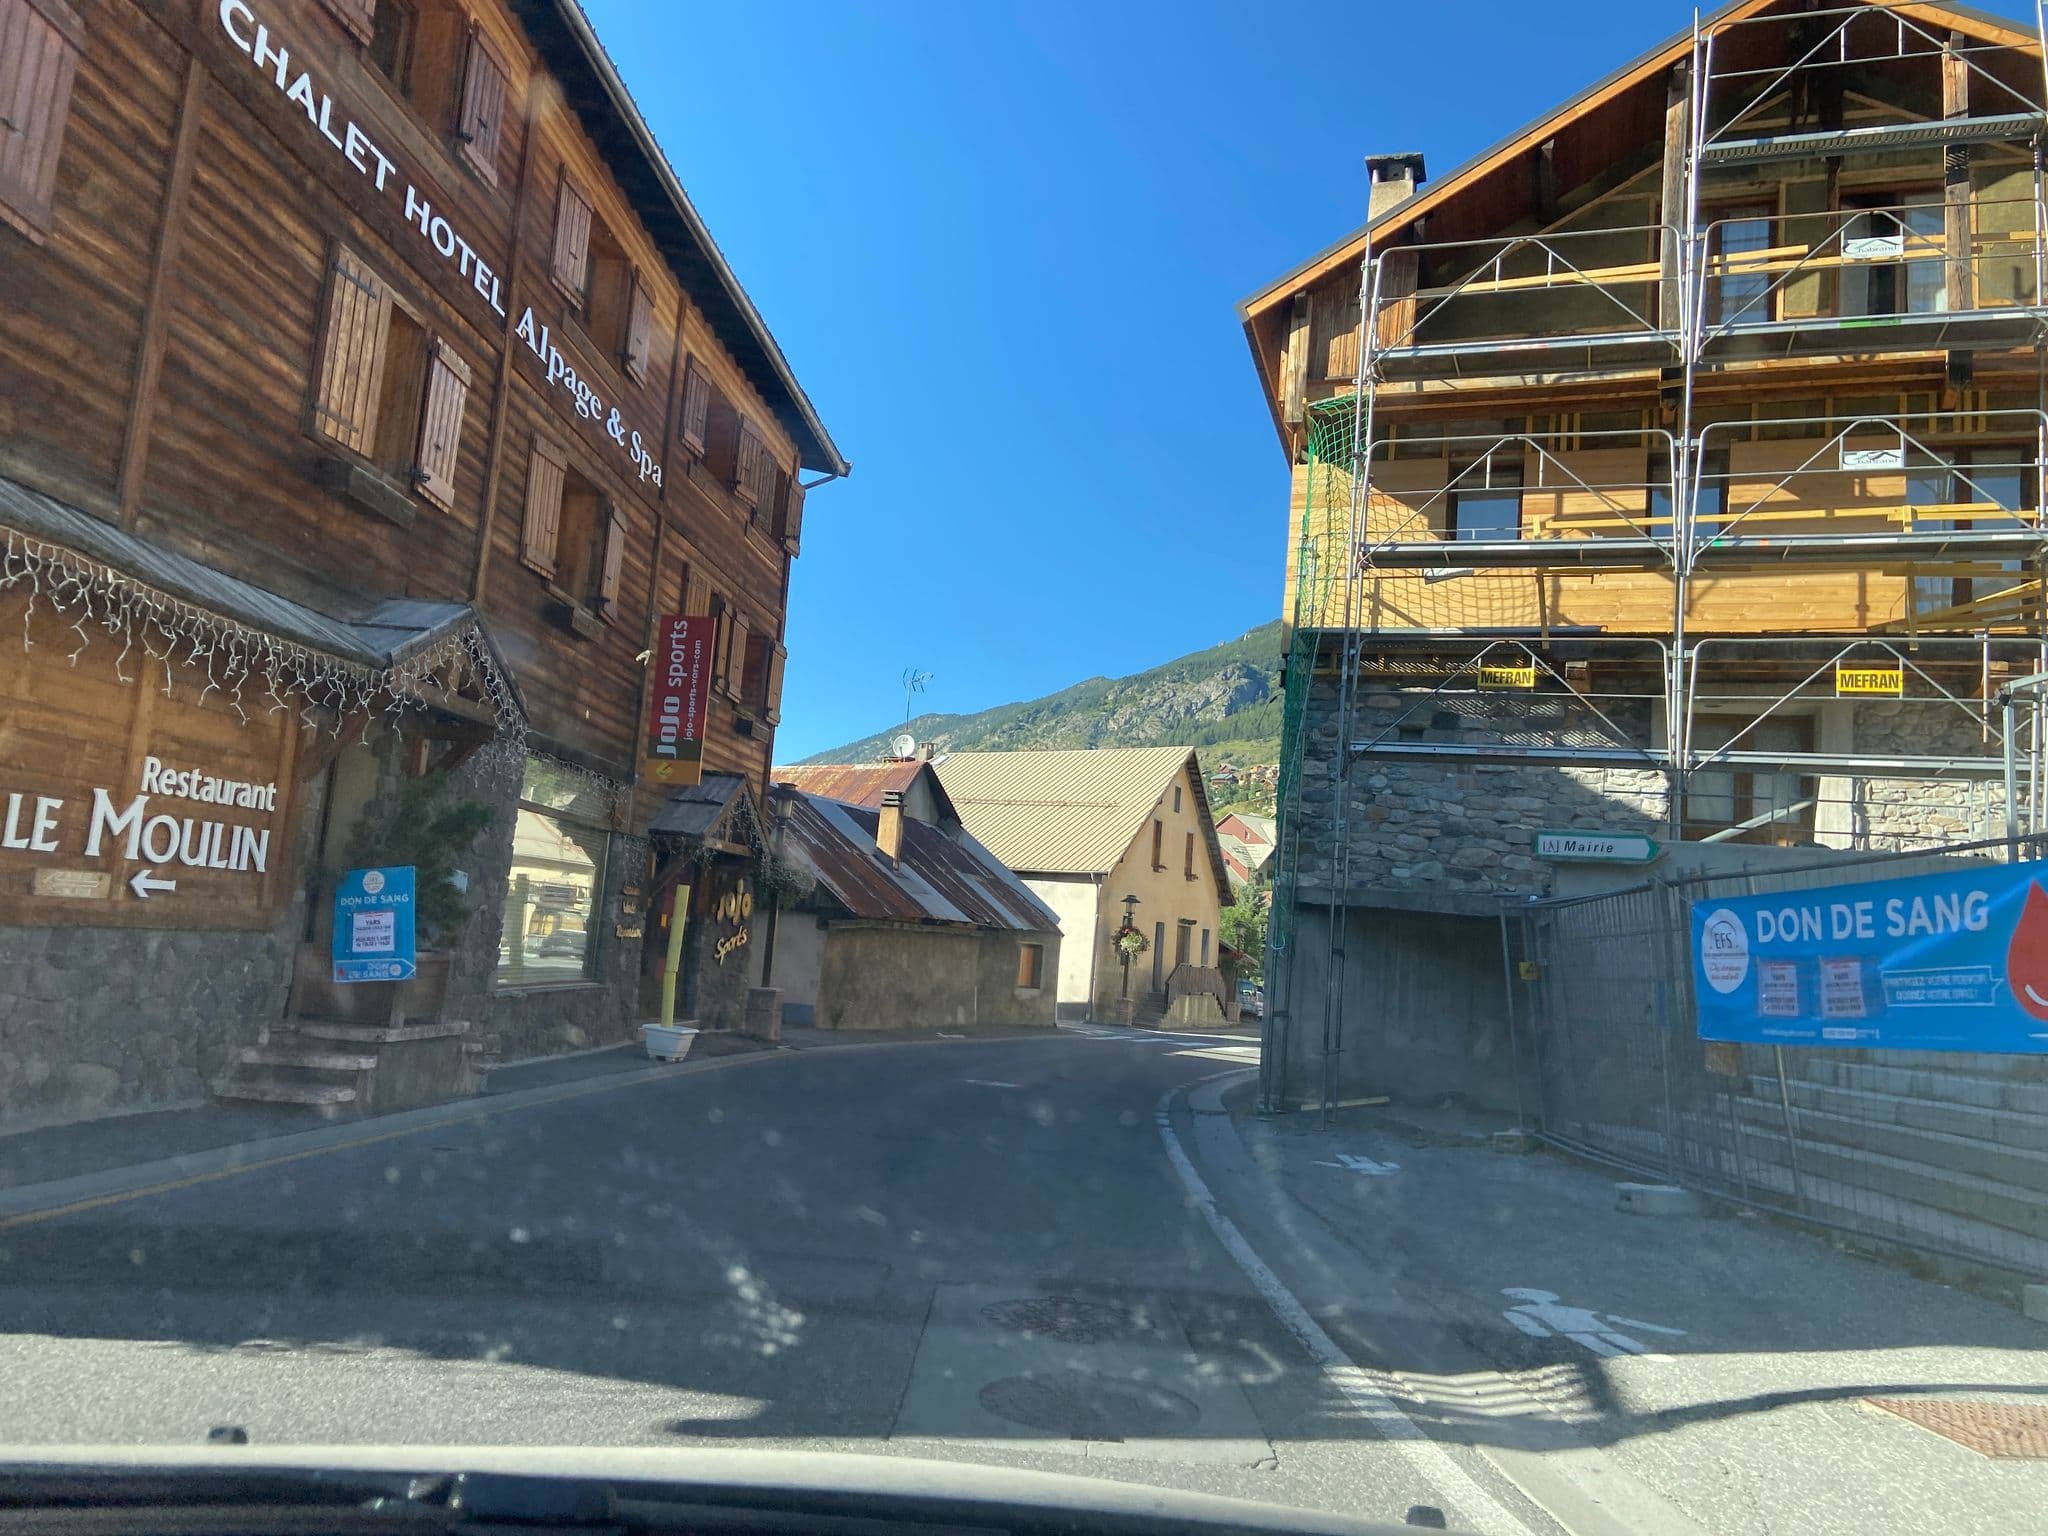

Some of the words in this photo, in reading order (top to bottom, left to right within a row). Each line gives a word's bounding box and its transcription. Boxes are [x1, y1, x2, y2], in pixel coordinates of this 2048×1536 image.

[219, 0, 396, 192] CHALET
[403, 184, 507, 318] HOTEL
[515, 306, 603, 421] Alpage
[606, 407, 627, 446] &
[629, 429, 663, 489] Spa
[668, 619, 688, 688] sports
[1480, 671, 1531, 684] MEFRAN
[1840, 673, 1899, 689] MEFRAN
[141, 756, 277, 812] Restaurant
[1, 793, 64, 852] LE
[84, 788, 271, 873] MOULIN
[1563, 840, 1615, 853] Mairie
[340, 896, 362, 906] DON
[364, 895, 378, 904] DE
[381, 893, 410, 904] SANG
[1756, 905, 1823, 944] DON
[1831, 901, 1876, 940] DE
[1886, 890, 1990, 937] SANG
[1714, 932, 1734, 950] EFS
